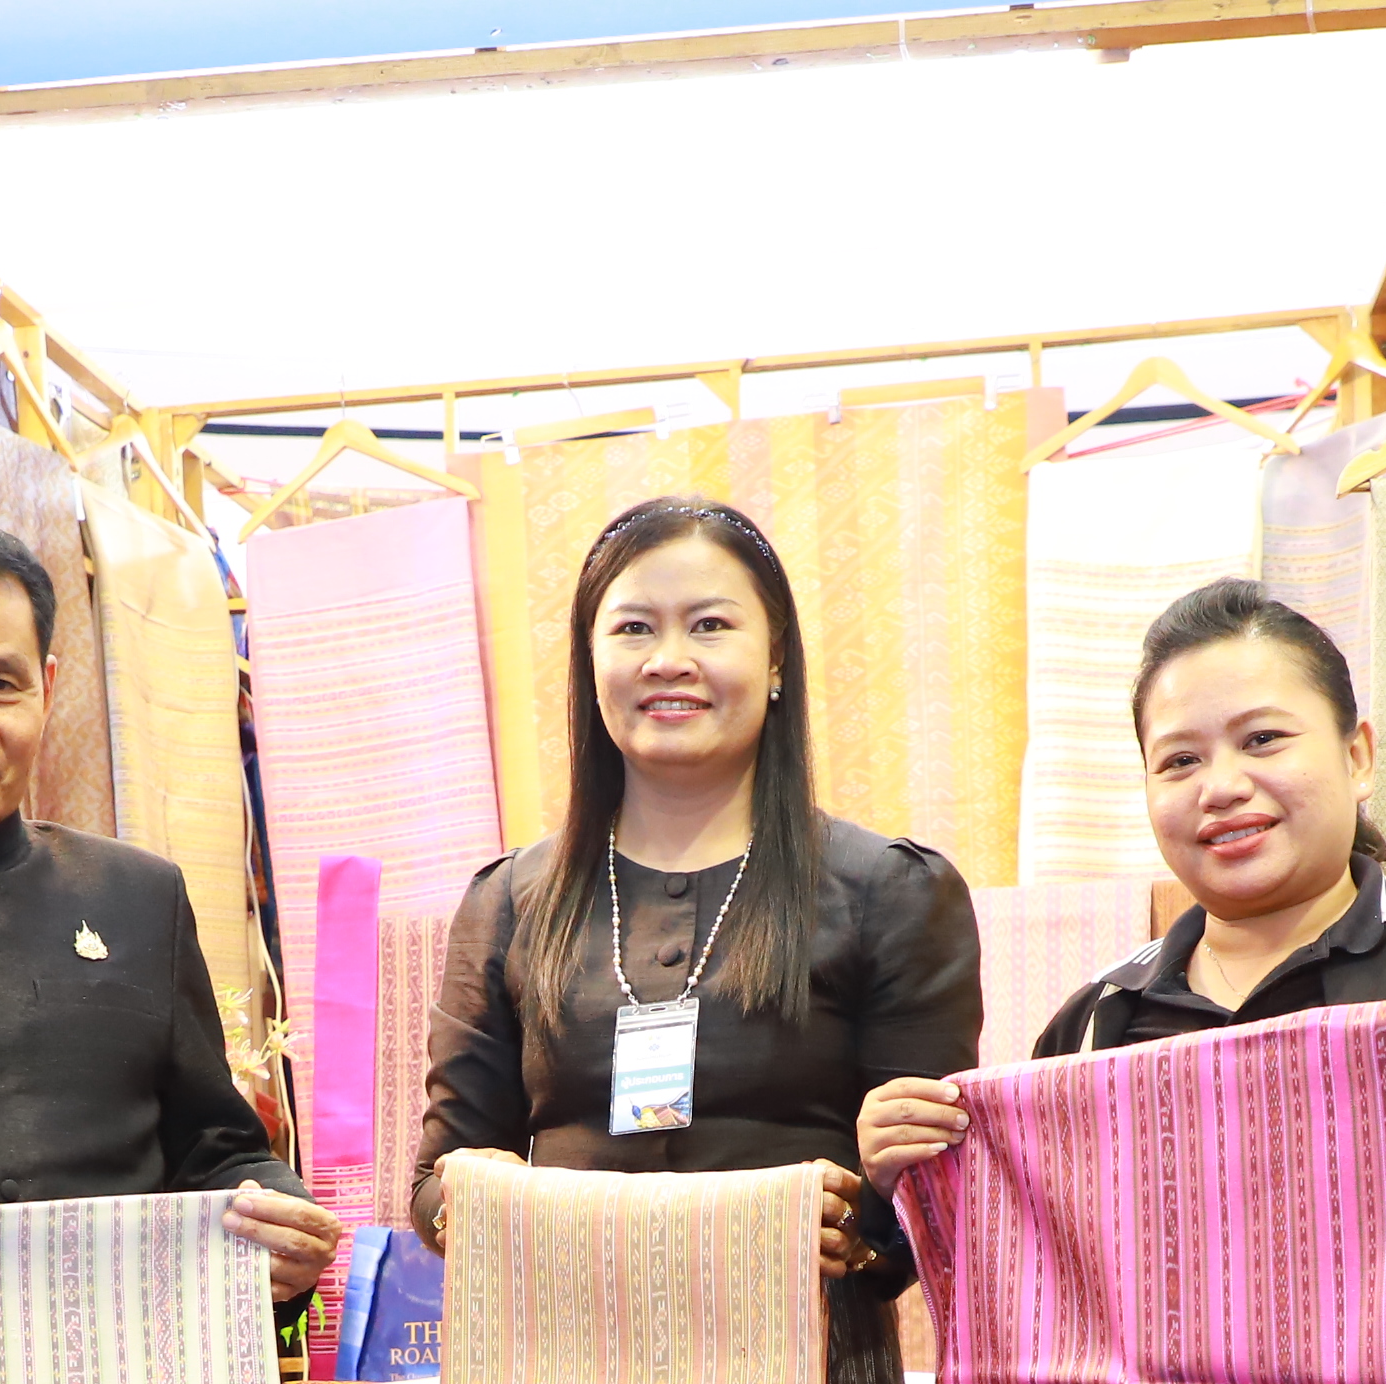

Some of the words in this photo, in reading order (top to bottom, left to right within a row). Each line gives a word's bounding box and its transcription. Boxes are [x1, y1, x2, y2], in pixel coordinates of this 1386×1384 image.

[620, 1072, 685, 1090] ผู้ประกอบการ
